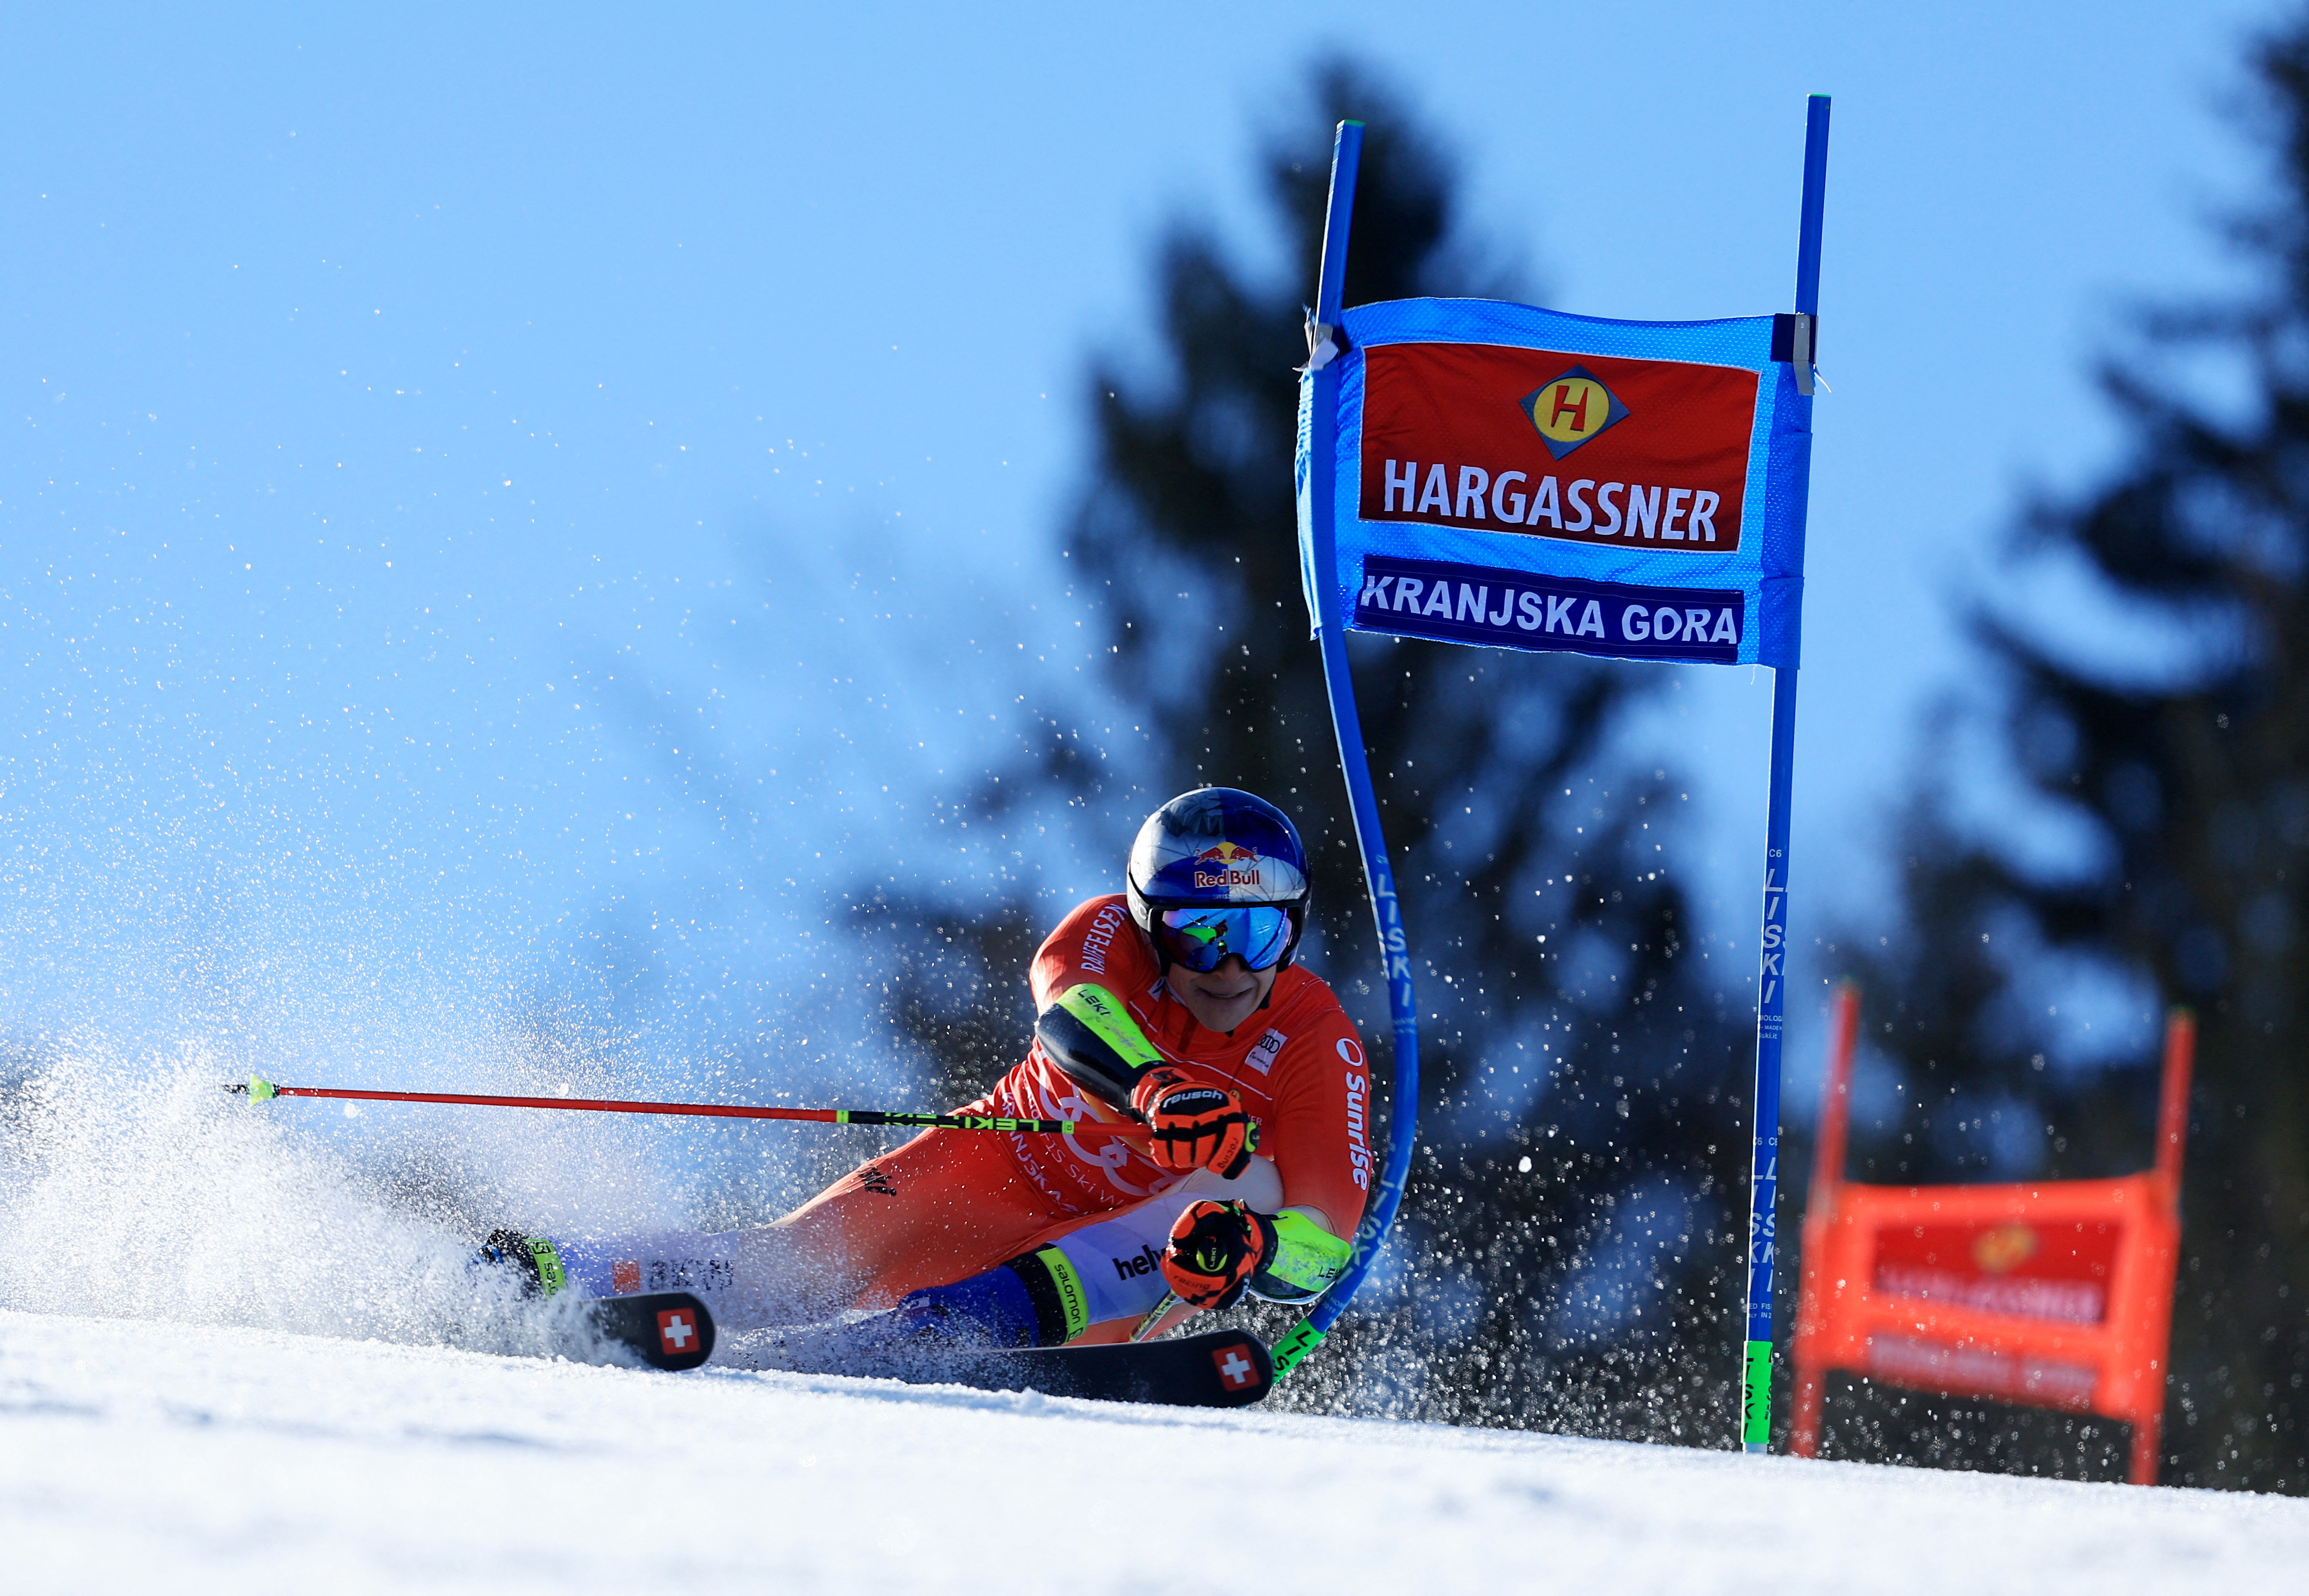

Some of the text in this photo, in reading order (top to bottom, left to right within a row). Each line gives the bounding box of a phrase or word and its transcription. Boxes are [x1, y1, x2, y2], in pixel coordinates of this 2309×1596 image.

[1551, 385, 1590, 432] H
[1383, 458, 1721, 542] HARGASSNER
[1360, 575, 1737, 645] KRANJSKA GORA
[1768, 849, 1782, 858] C6
[1195, 869, 1260, 888] Red Bull
[1377, 873, 1412, 1007] LISKI
[1762, 868, 1784, 1004] LISKI
[1078, 989, 1111, 1016] LEKI
[1163, 1089, 1223, 1108] reusch
[964, 1115, 1039, 1132] LEKI
[1002, 1092, 1064, 1205] KRNJSKA
[1039, 1132, 1066, 1163] FIS
[1209, 1247, 1217, 1268] LEKI
[1274, 1330, 1311, 1377] LIS
